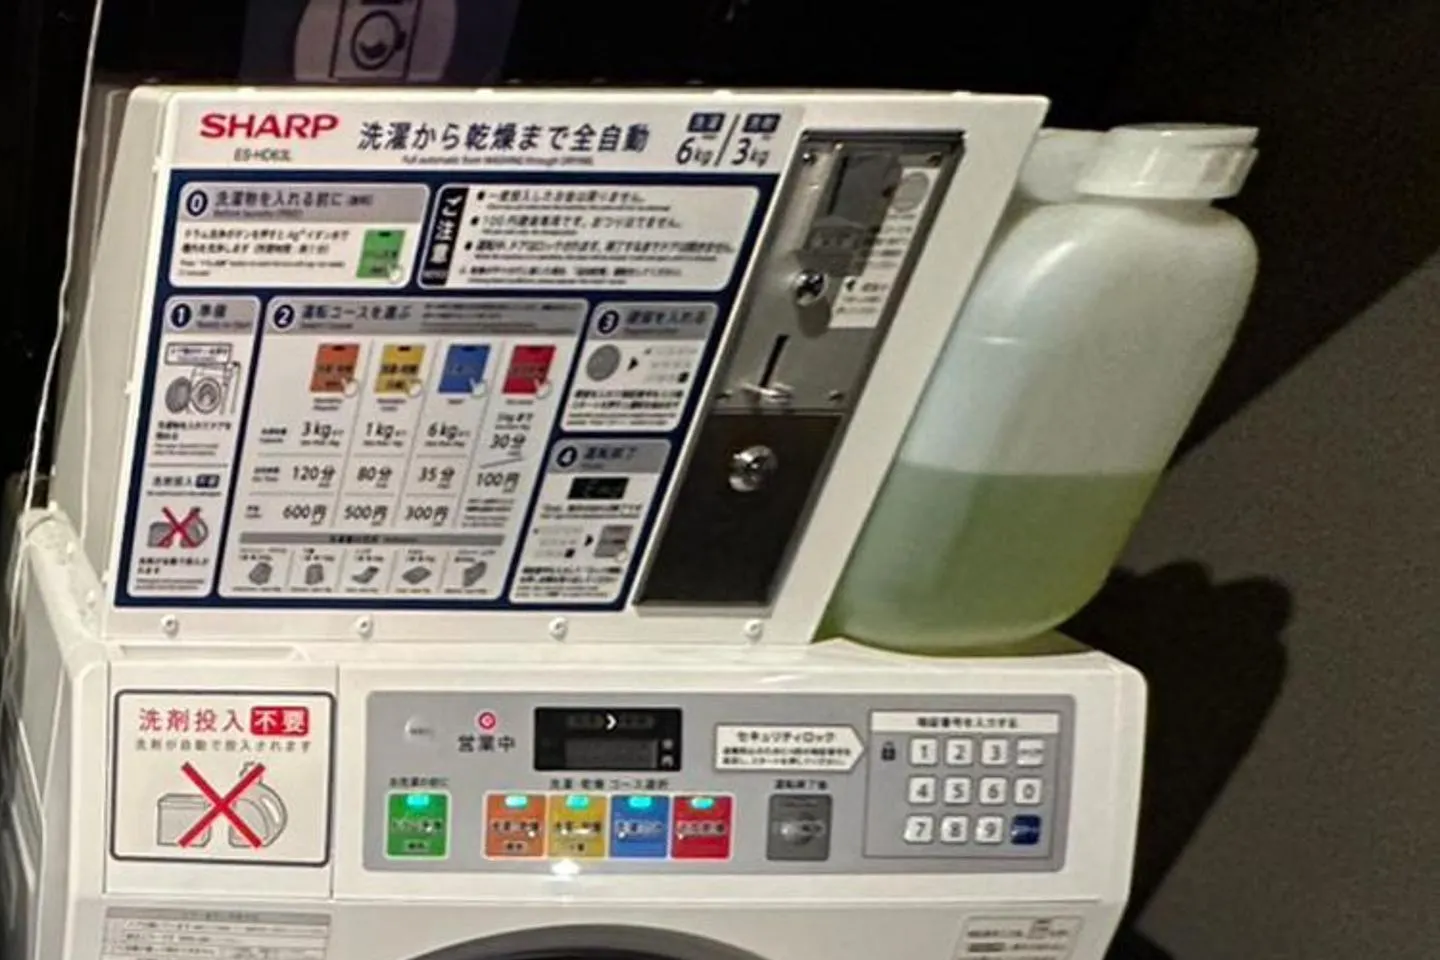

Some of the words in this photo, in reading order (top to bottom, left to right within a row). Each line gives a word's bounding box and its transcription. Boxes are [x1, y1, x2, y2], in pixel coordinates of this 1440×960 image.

[200, 113, 339, 139] SHARP
[358, 121, 650, 152] 洗濯から乾燥まで全自動
[292, 465, 336, 483] 120分
[357, 465, 393, 482] 80分
[418, 466, 456, 484] 35分
[477, 471, 521, 489] 100円
[283, 504, 327, 522] 600円
[344, 504, 389, 522] 500円
[406, 505, 450, 523] 300円
[139, 708, 245, 732] 洗剤投入
[253, 708, 307, 734] 不要
[458, 735, 516, 753] 営業中
[737, 731, 835, 743] セキュリティロック
[136, 738, 312, 753] 洗剤が自動で投入されます
[920, 745, 929, 759] 1
[954, 745, 966, 760] 2
[991, 746, 1002, 760] 3
[915, 784, 928, 798] 4
[952, 784, 964, 799] 5
[988, 784, 999, 799] 6
[1022, 784, 1036, 799] 0
[915, 822, 927, 837] 7
[950, 822, 962, 837] 8
[985, 822, 997, 837] 9
